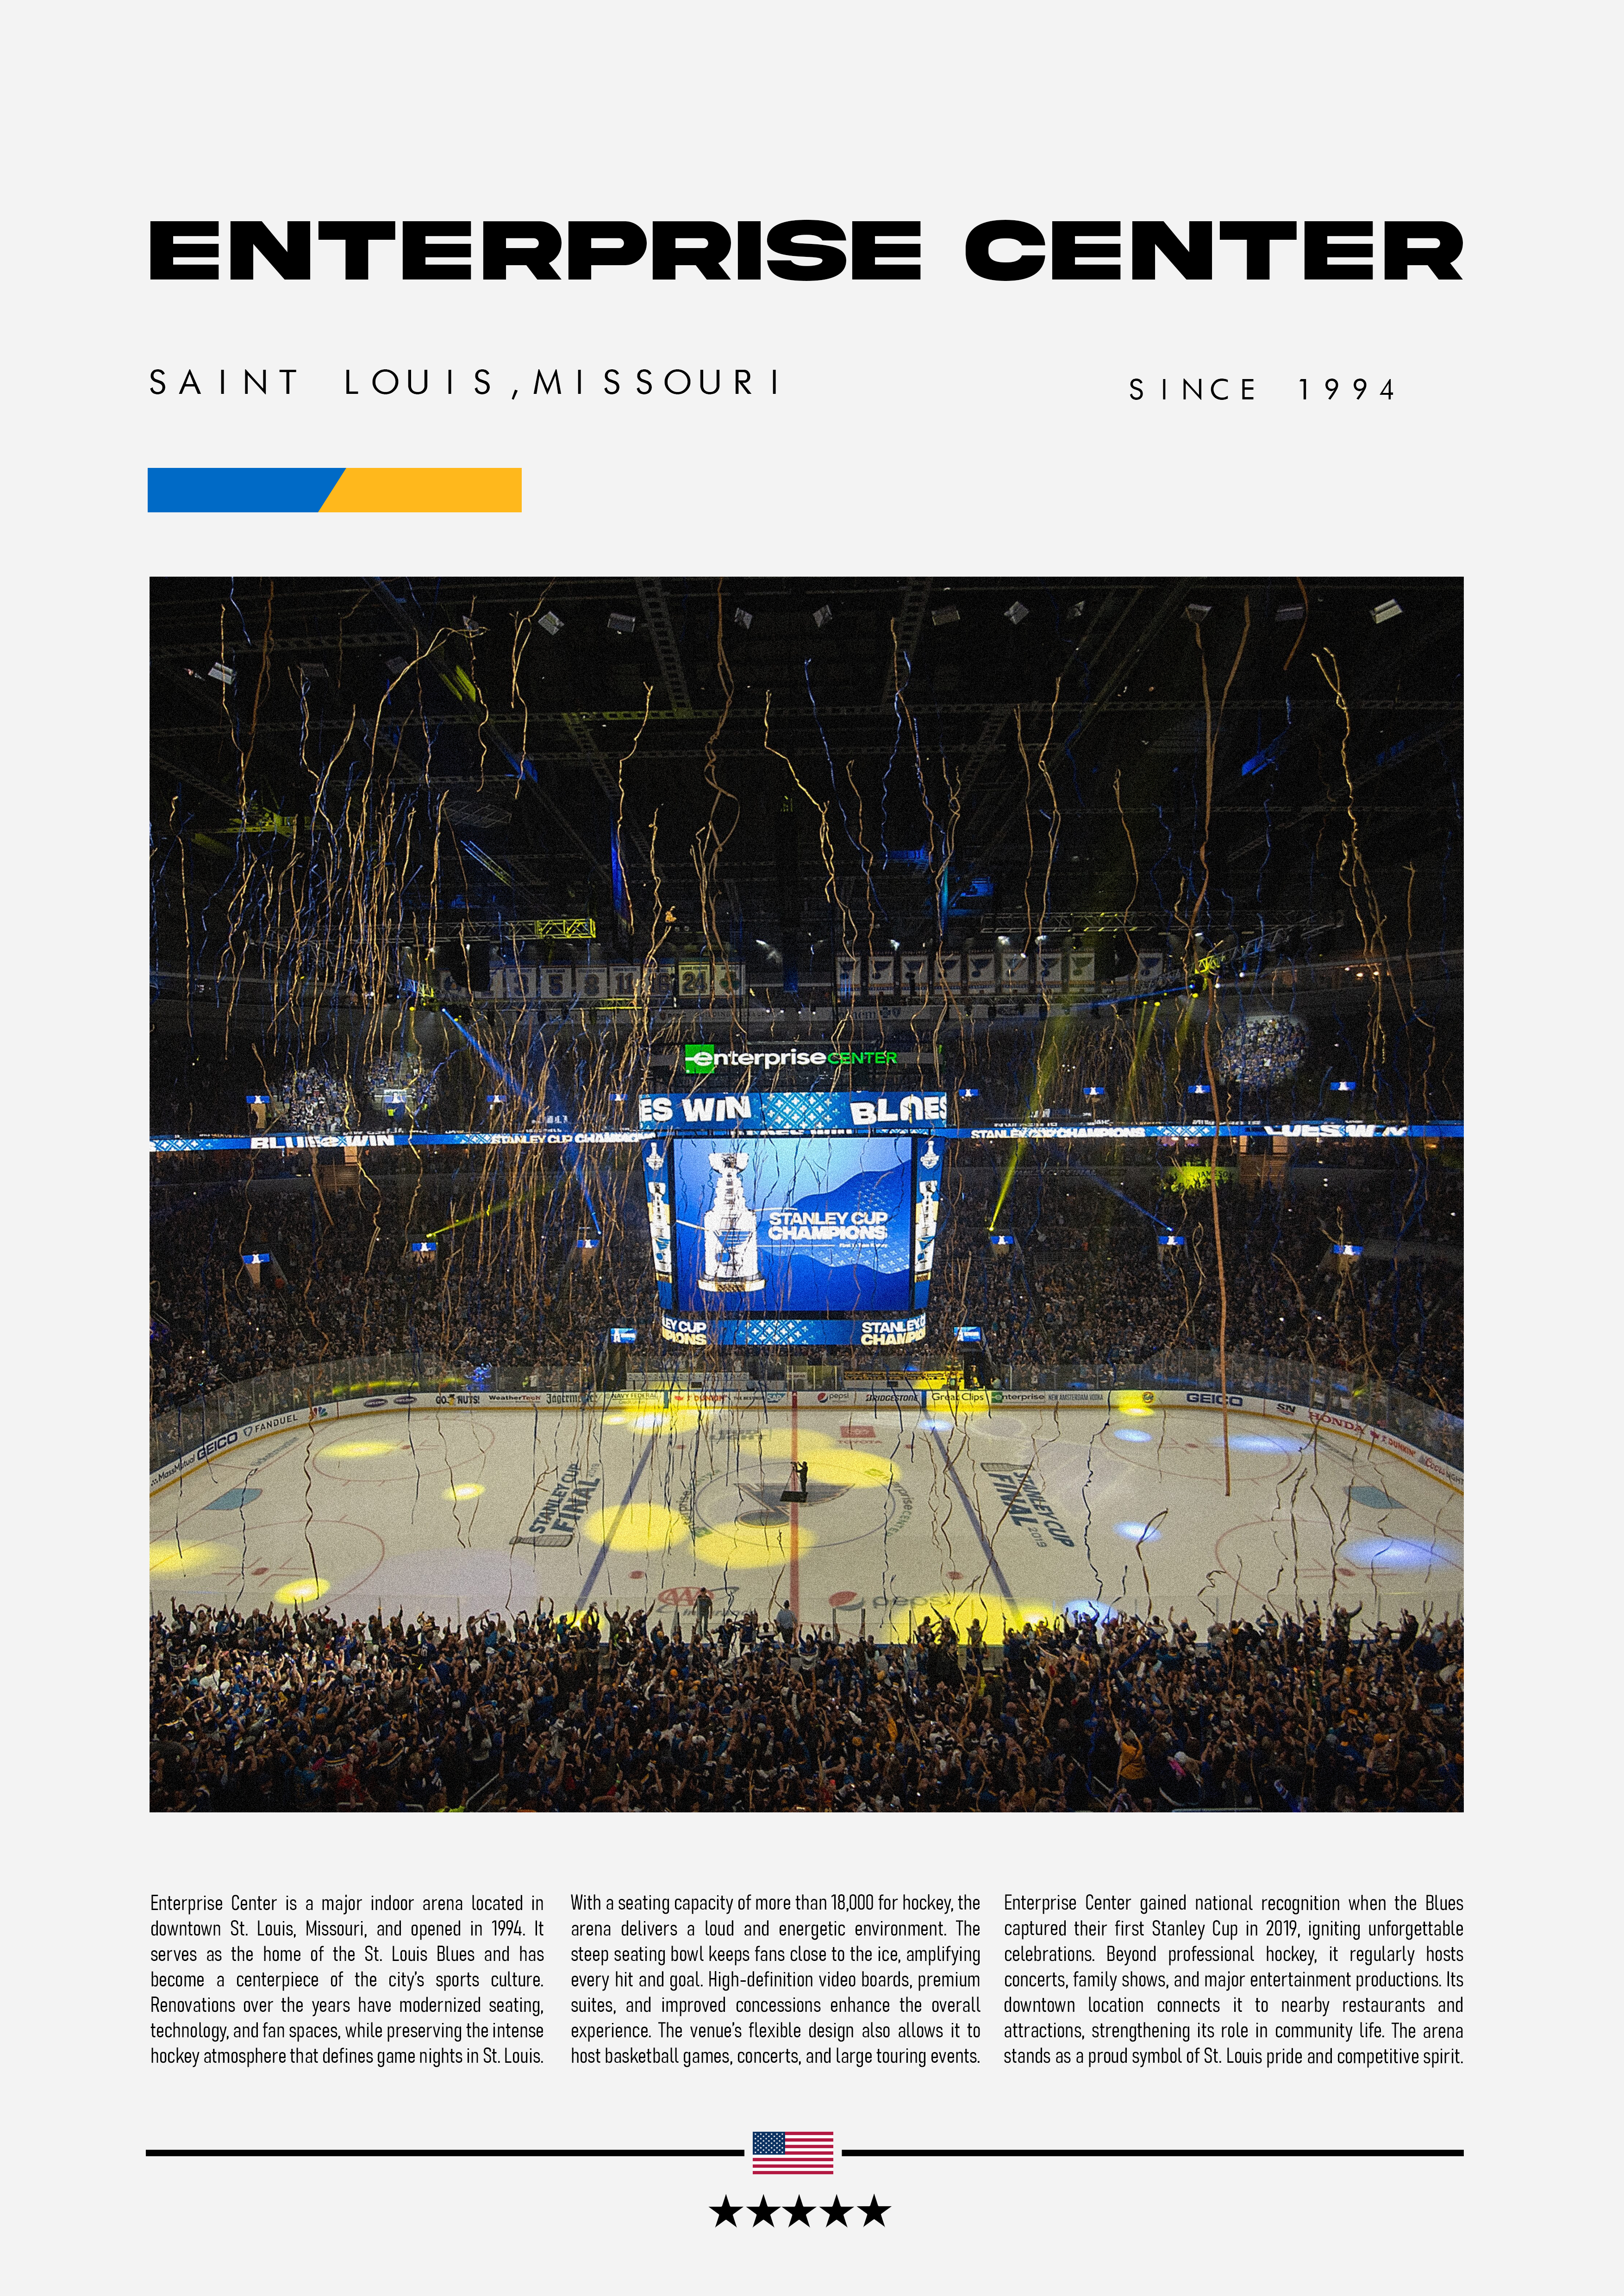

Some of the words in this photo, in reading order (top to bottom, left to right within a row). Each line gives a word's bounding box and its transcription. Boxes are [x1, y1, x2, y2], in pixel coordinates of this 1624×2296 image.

[514, 974, 529, 996] 3
[549, 974, 563, 996] 5
[682, 971, 707, 993] 24
[681, 1095, 752, 1122] WIN
[1057, 1128, 1146, 1138] CHAMPIONS
[769, 1211, 849, 1225] STANLEY
[851, 1211, 888, 1225] CUP
[768, 1225, 888, 1241] CHAMPIONS
[678, 1320, 707, 1333] CUP
[457, 1395, 480, 1404] NUTS!
[767, 1394, 784, 1402] SAP
[931, 1393, 960, 1401] Great
[962, 1393, 984, 1403] Clips
[994, 1393, 1045, 1401] enterprise
[1187, 1393, 1243, 1407] GEICO
[1276, 1403, 1296, 1413] SN
[255, 1413, 299, 1433] FANDUEL
[1309, 1412, 1365, 1435] HONDA
[197, 1431, 238, 1461] GEICO
[158, 1454, 195, 1482] MassMutual
[529, 1482, 570, 1534] STANLEY
[561, 1463, 581, 1483] CUP
[551, 1478, 601, 1533] FINAL
[987, 1473, 1039, 1527] FINAL
[1027, 1526, 1048, 1548] 2019
[1013, 1472, 1059, 1521] STANLEY
[1043, 1520, 1075, 1548] CUP
